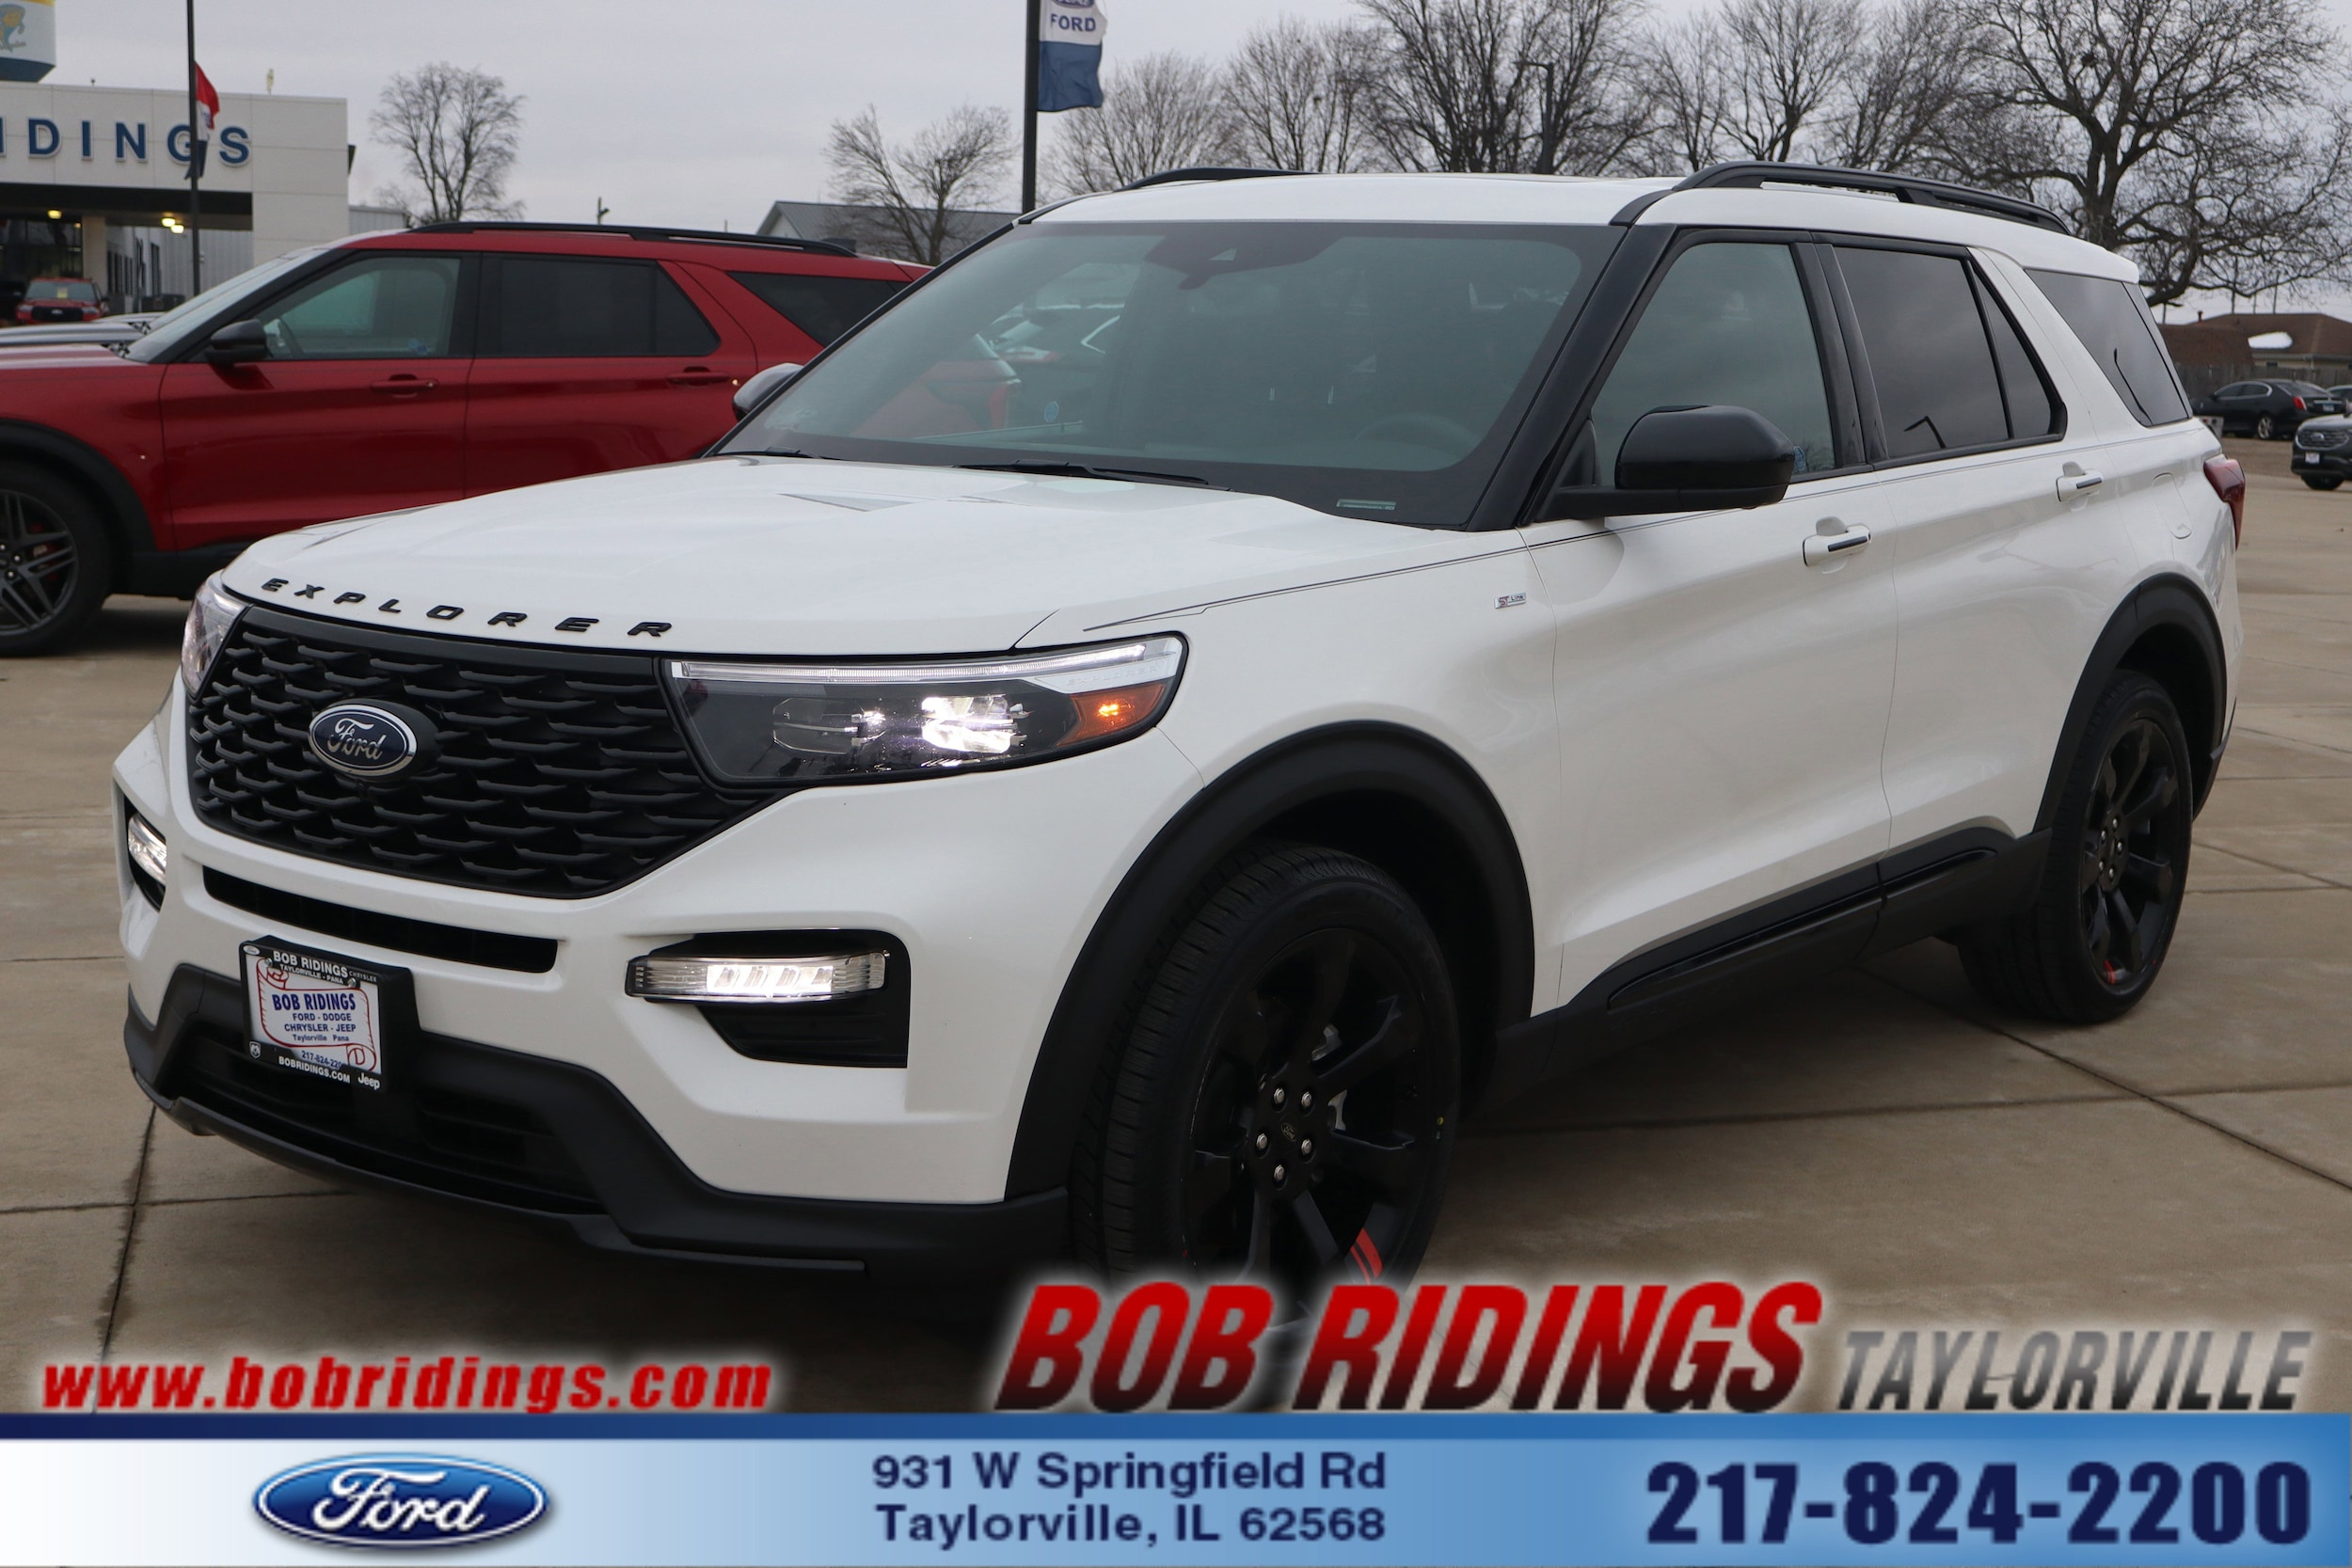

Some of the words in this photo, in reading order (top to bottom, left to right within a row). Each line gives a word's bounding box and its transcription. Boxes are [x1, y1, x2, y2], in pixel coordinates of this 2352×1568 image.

[1050, 13, 1097, 32] FORD
[261, 577, 673, 638] EXPLORER
[326, 718, 388, 761] Ford
[273, 950, 298, 966] BOB
[301, 957, 349, 978] RIDINGS
[279, 964, 321, 979] TAYLORVILLE
[326, 974, 344, 985] PANA
[349, 970, 377, 982] CHRYSLER
[272, 993, 301, 1011] BOB
[303, 992, 357, 1011] RIDINGS
[293, 1012, 316, 1022] FORD
[323, 1012, 353, 1022] DODGE
[284, 1023, 329, 1032] CHRYSLER
[336, 1023, 357, 1032] JEEP
[293, 1034, 327, 1043] Taylorville
[332, 1034, 349, 1042] Pana
[301, 1050, 344, 1070] 217-824-220
[278, 1055, 351, 1085] BOBRIDINGS.COM
[358, 1072, 380, 1091] Jeep
